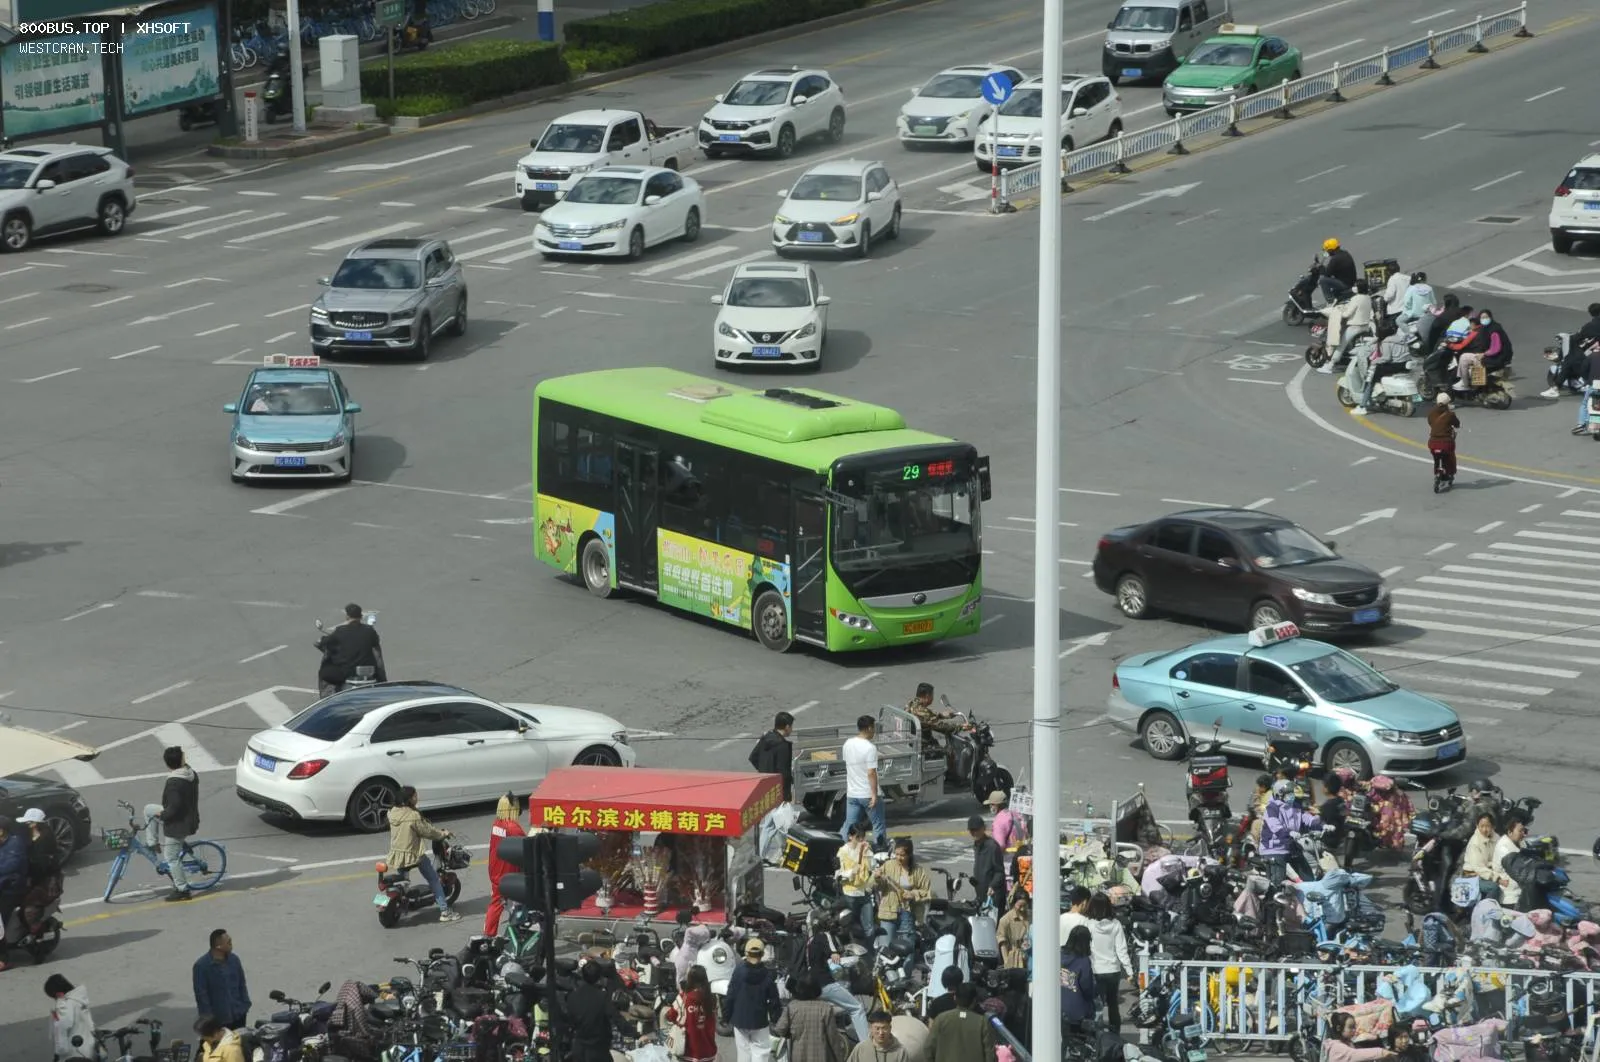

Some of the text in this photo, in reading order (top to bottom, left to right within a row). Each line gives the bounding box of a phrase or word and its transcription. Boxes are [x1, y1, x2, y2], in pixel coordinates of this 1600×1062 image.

[903, 464, 920, 480] 29
[543, 805, 726, 833] 哈尔滨冰糖葫芦
